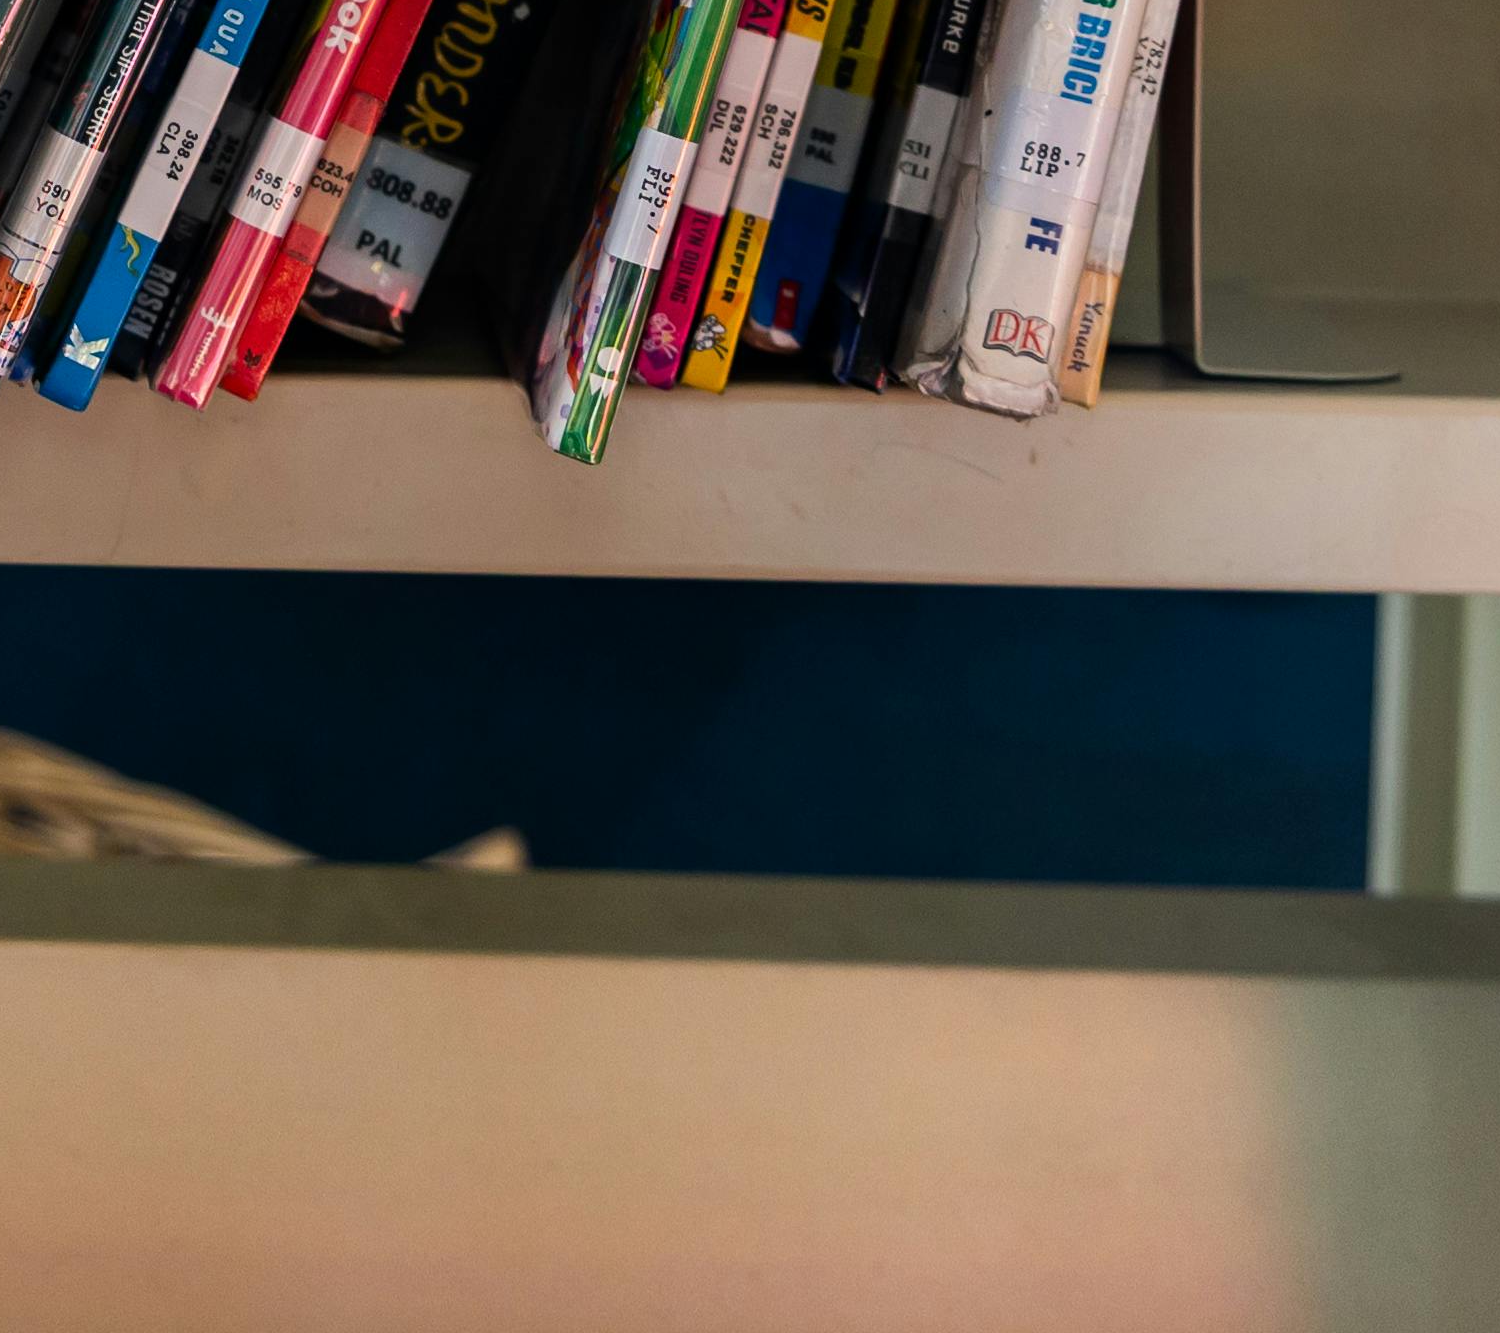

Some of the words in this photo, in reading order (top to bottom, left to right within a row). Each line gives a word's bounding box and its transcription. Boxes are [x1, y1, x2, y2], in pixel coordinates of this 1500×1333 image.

[1057, 12, 1112, 105] BRIC
[706, 98, 731, 136] DUL
[717, 104, 748, 166] 629.222
[754, 102, 780, 140] SCH
[154, 120, 182, 158] CLA
[163, 127, 199, 183] 398.24
[765, 107, 798, 171] 796.332
[1023, 139, 1087, 171] 688.7
[635, 165, 662, 204] FLI
[1019, 155, 1061, 179] LIP
[245, 185, 285, 211] MOS
[352, 230, 407, 268] PAL
[1022, 216, 1062, 257] FE
[986, 311, 1052, 360] DK
[1066, 298, 1107, 377] Yanuck
